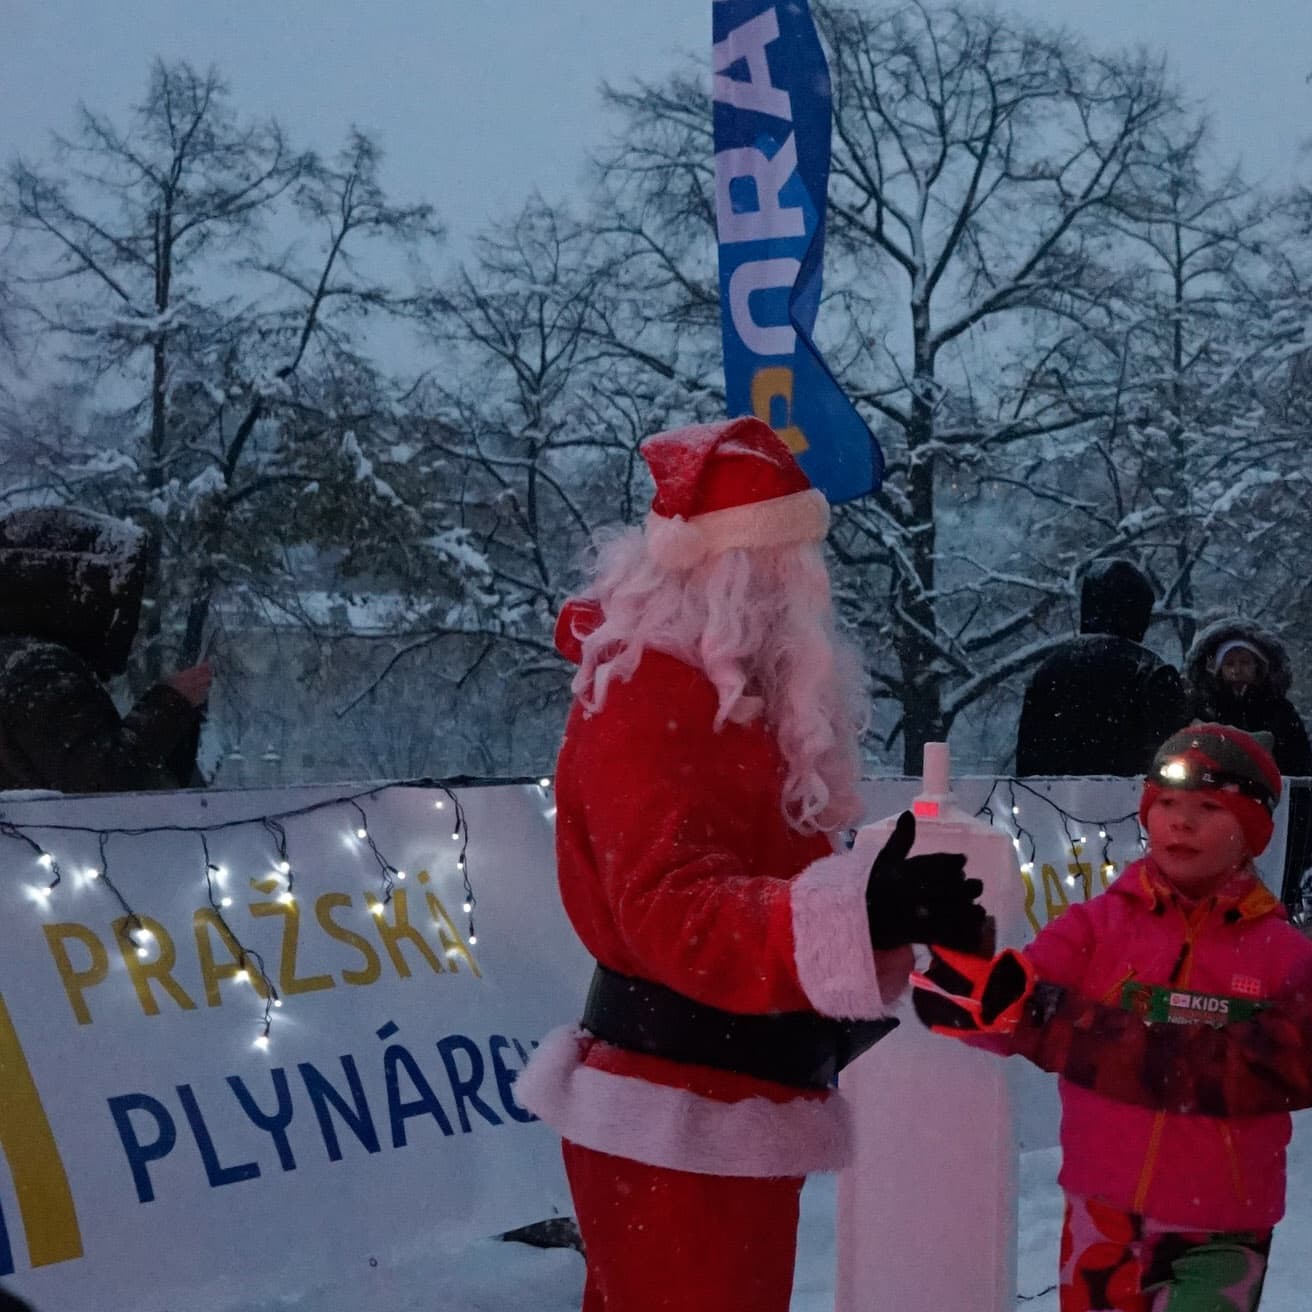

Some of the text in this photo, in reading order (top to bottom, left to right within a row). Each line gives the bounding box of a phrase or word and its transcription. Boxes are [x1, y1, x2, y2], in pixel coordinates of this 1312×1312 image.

[42, 870, 483, 1026] PRAŽSKÁ
[1191, 995, 1230, 1014] KIDS
[107, 1020, 542, 1204] PLYNÁRE
